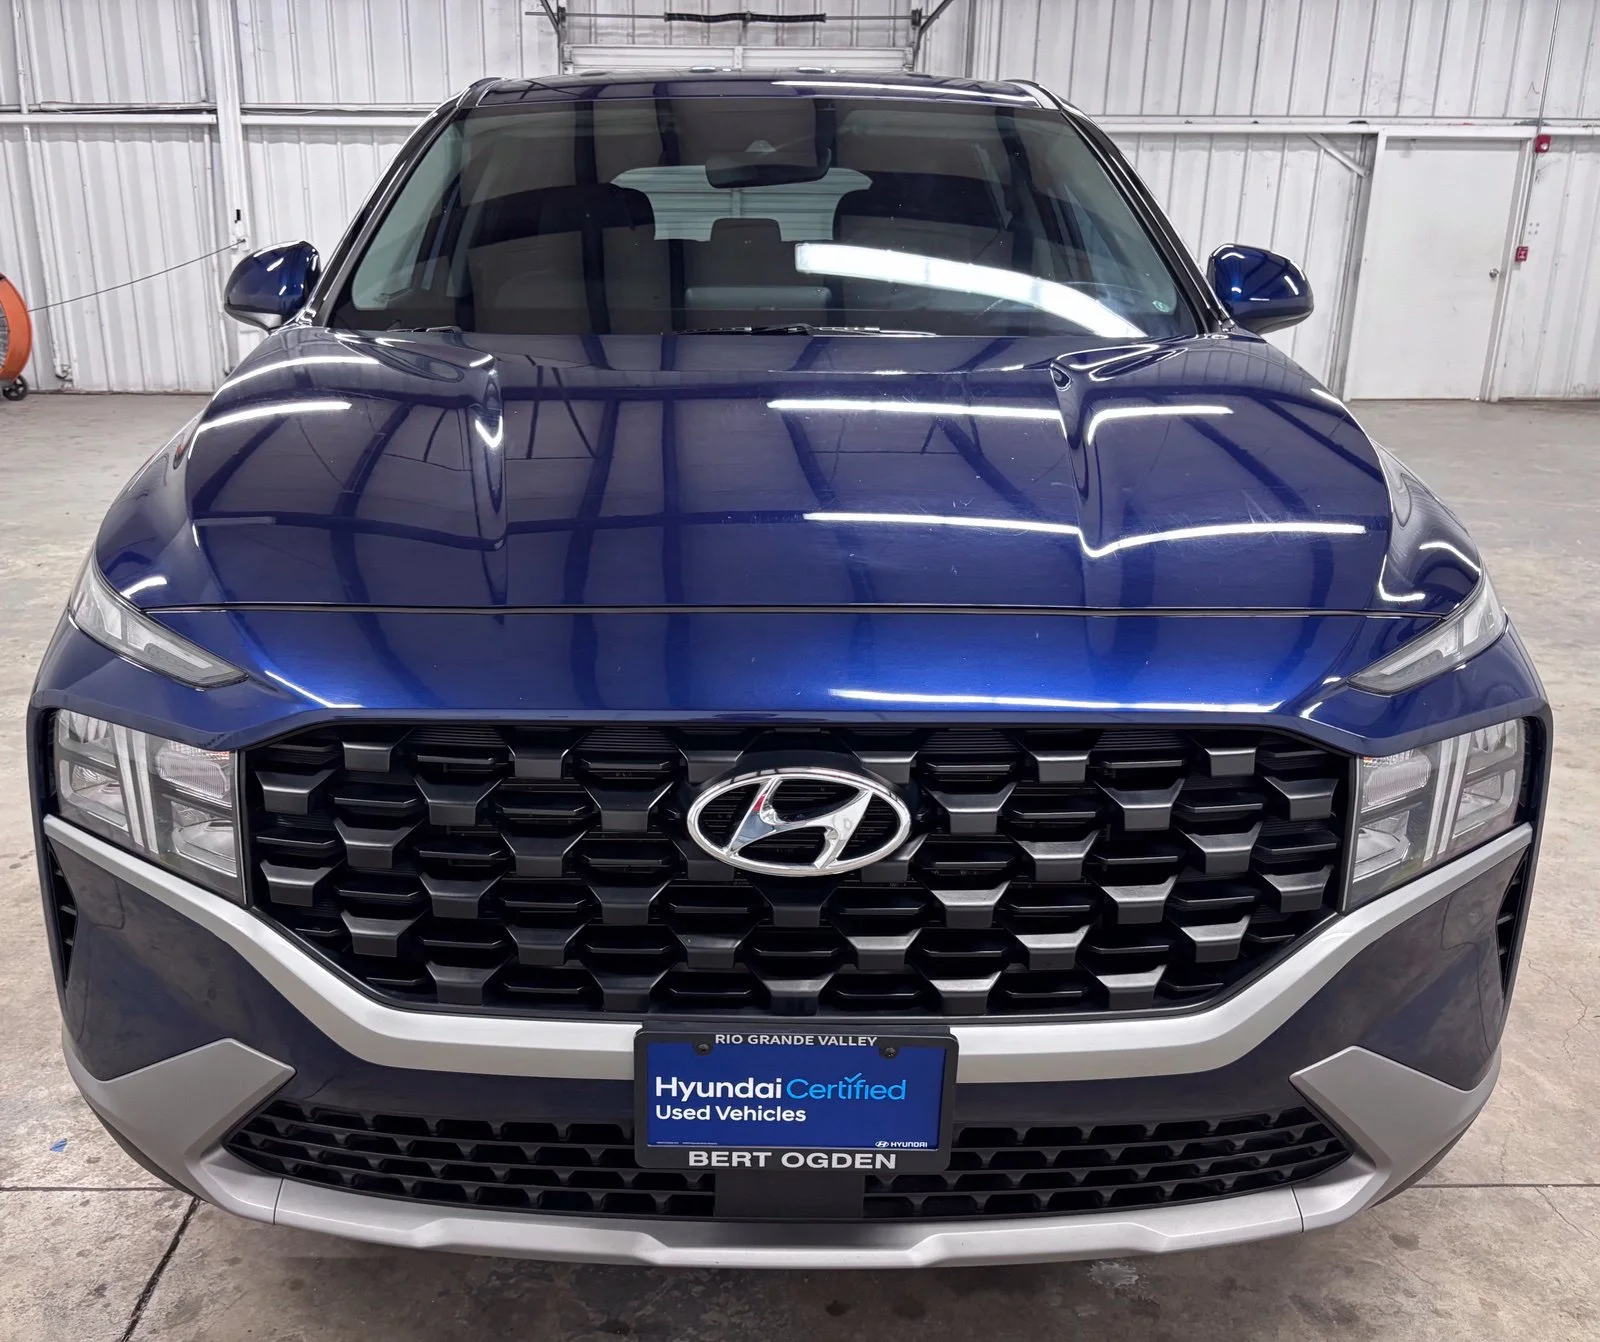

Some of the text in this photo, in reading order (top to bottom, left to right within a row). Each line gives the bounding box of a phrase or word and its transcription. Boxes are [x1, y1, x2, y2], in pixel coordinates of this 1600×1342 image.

[715, 1034, 878, 1047] RIO GRANDE VALLEY
[655, 1073, 907, 1102] Hyundai Certified
[655, 1105, 807, 1122] Used Vehicles
[688, 1151, 896, 1169] BERT OGDEN
